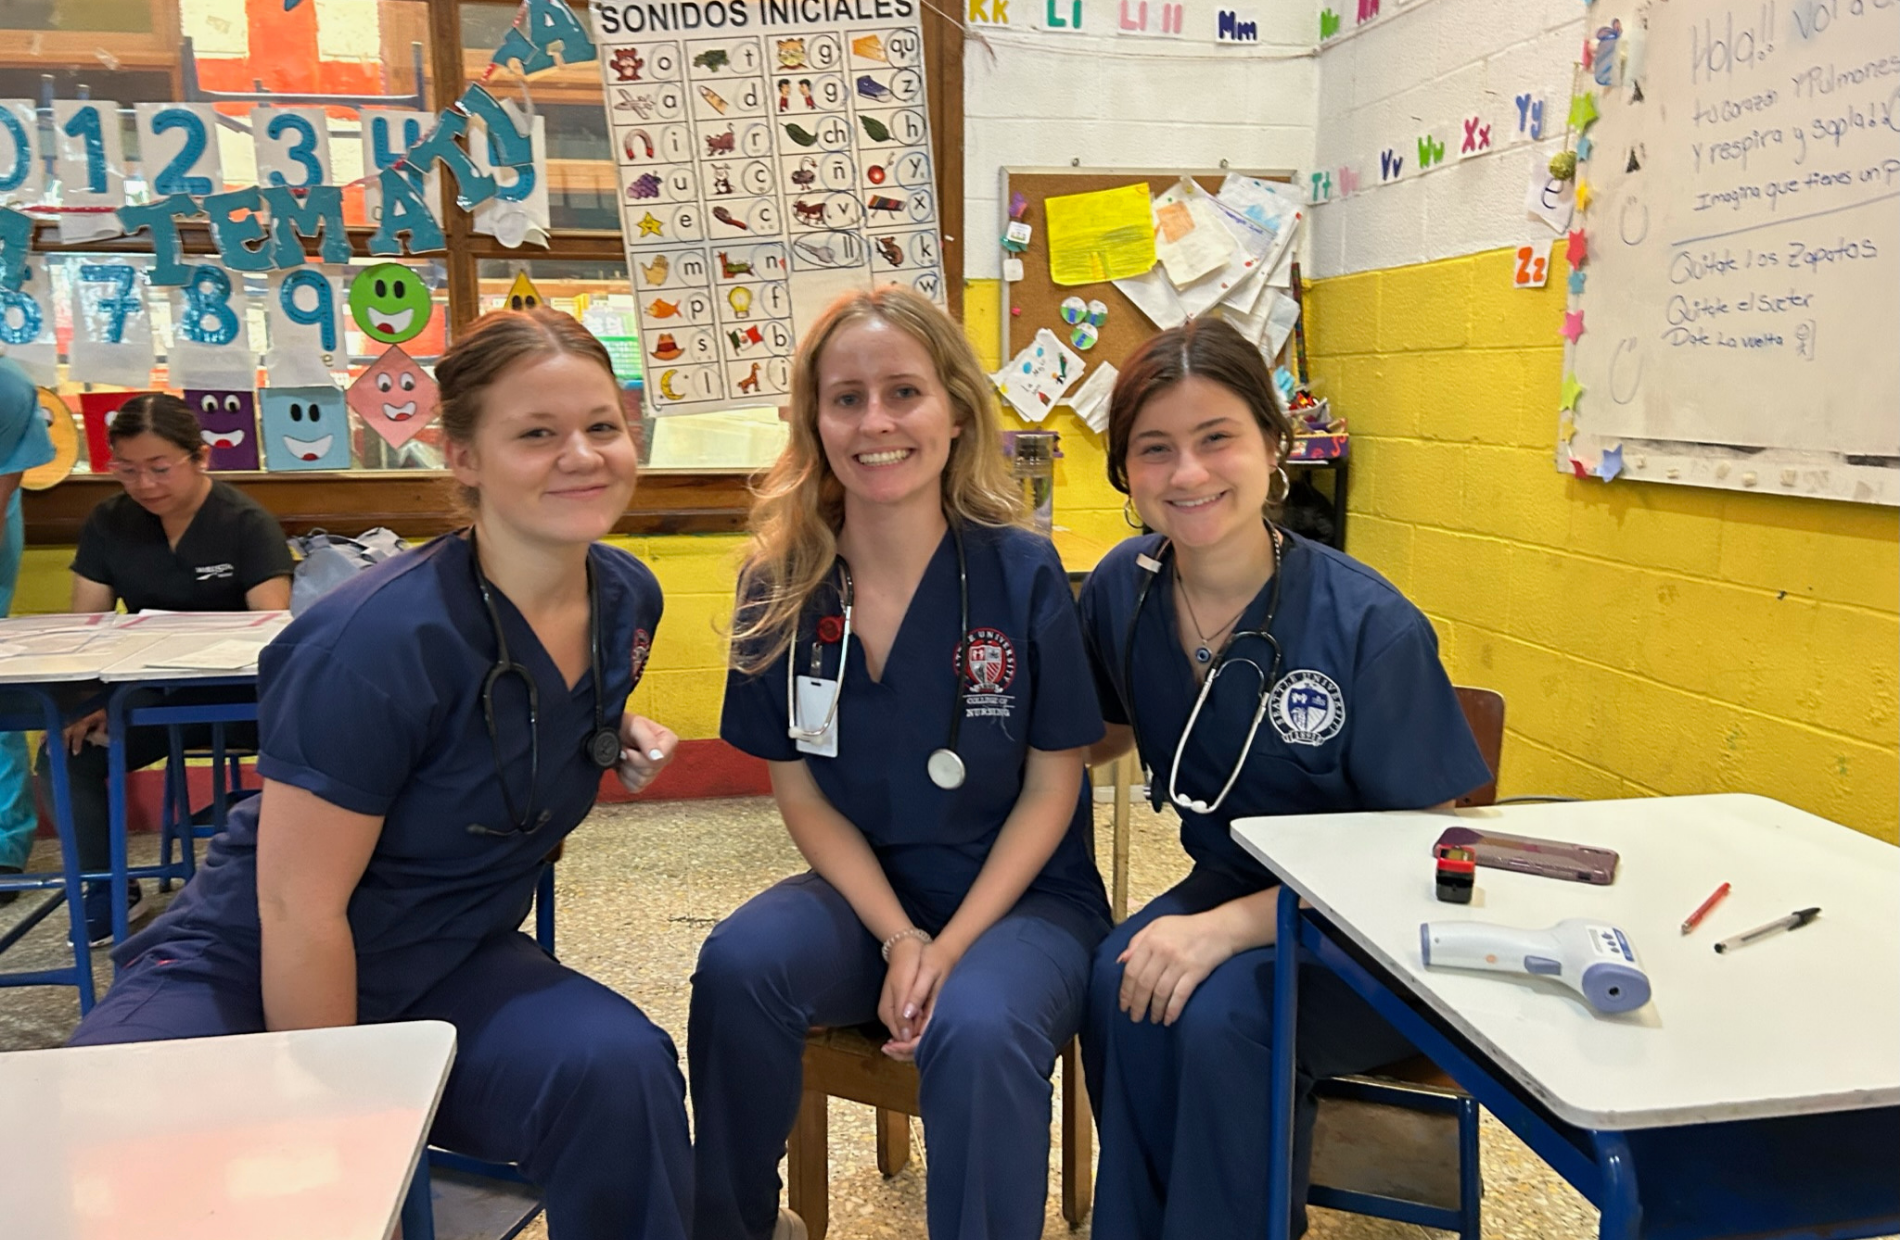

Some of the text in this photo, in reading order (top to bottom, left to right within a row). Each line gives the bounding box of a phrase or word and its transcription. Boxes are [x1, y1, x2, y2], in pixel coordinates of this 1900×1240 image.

[601, 0, 915, 33] SONIDOS INICIALES
[968, 0, 1009, 24] Kk
[1218, 10, 1258, 40] Mm
[744, 49, 754, 67] t
[819, 44, 834, 64] g
[890, 39, 915, 60] qu
[658, 56, 672, 71] o
[743, 83, 757, 107] d
[825, 82, 838, 103] g
[902, 80, 914, 93] z
[662, 94, 677, 109] a
[906, 115, 918, 138] h
[1515, 93, 1544, 141] Yy
[671, 131, 679, 152] i
[752, 132, 761, 147] r
[824, 120, 847, 143] ch
[1462, 117, 1491, 153] Xx
[65, 106, 108, 193] 1
[152, 109, 212, 195] 2
[267, 113, 323, 189] 3
[1418, 134, 1445, 169] Ww
[833, 161, 846, 179] ñ
[909, 158, 922, 177] y
[1382, 149, 1403, 180] Vv
[674, 176, 688, 191] u
[755, 169, 767, 183] c
[1312, 171, 1332, 201] Tt
[914, 197, 926, 210] x
[1765, 180, 1800, 212] que
[759, 207, 771, 223] c
[837, 203, 849, 214] v
[679, 213, 693, 228] e
[843, 236, 854, 258] ll
[920, 236, 932, 257] k
[684, 261, 703, 276] m
[766, 255, 778, 269] n
[1516, 246, 1546, 284] Zz
[1746, 250, 1779, 268] los
[919, 279, 936, 293] w
[79, 264, 142, 343] 7
[181, 263, 239, 345] 8
[772, 286, 780, 308] f
[279, 269, 336, 352] 9
[691, 300, 704, 320] p
[698, 339, 707, 352] s
[773, 325, 787, 347] b
[780, 360, 787, 385] j
